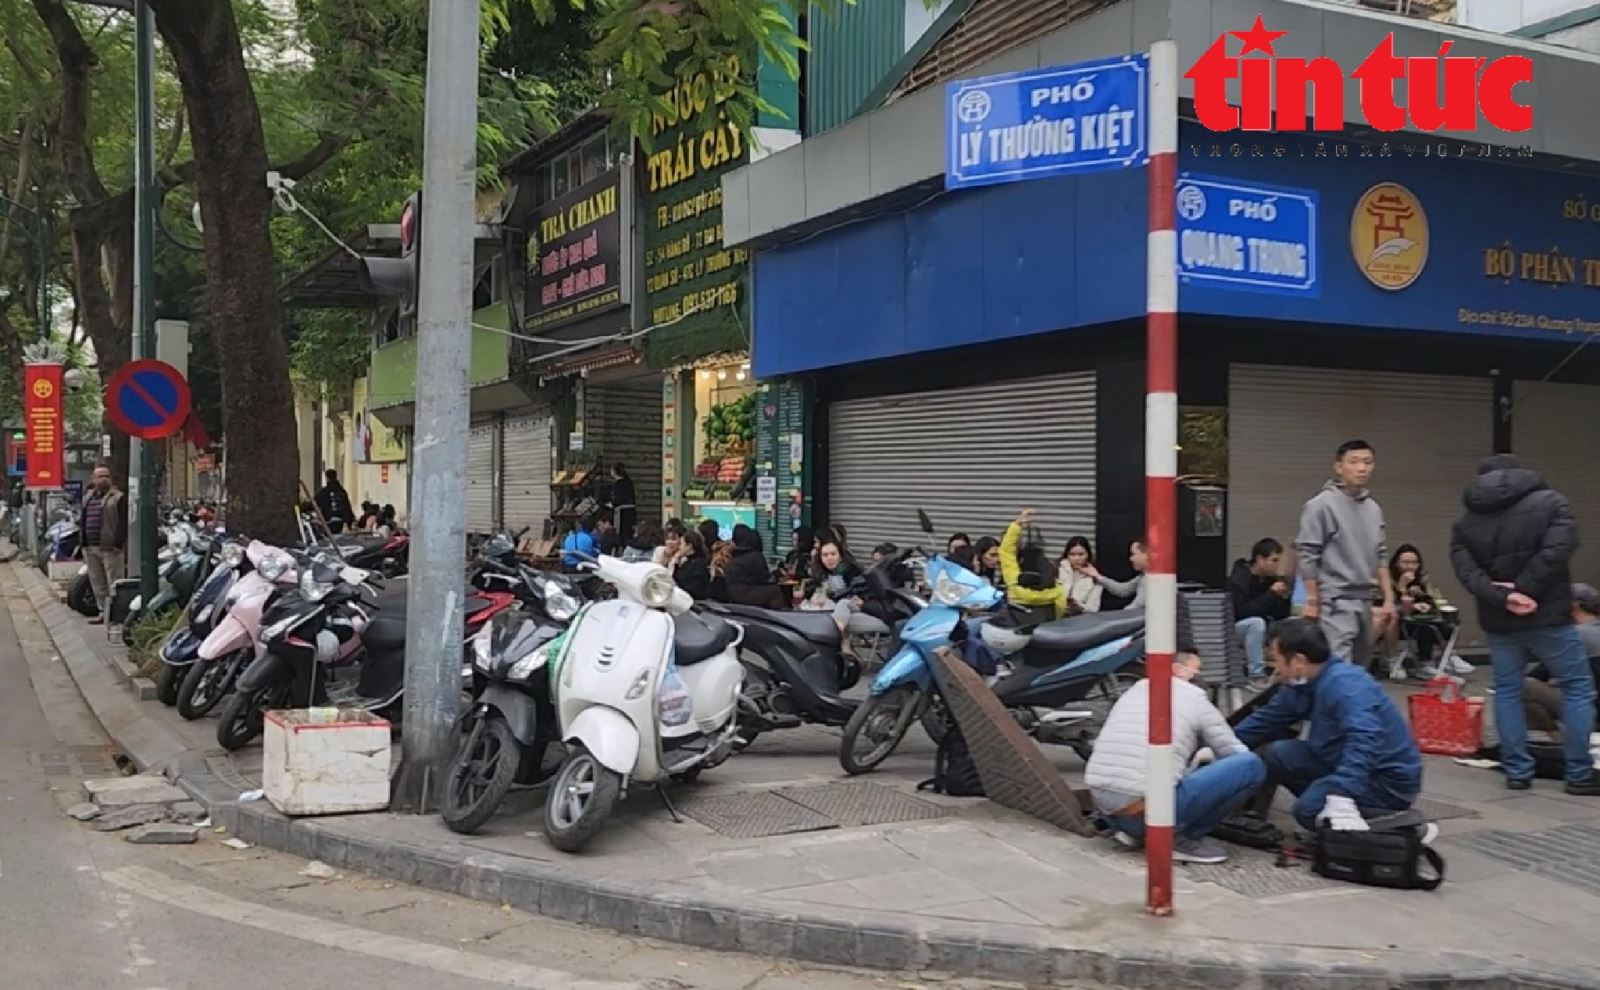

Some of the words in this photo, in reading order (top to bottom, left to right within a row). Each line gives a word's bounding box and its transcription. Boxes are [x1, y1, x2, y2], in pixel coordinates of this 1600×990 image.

[1031, 74, 1098, 107] PHỐ
[960, 125, 983, 167] LÝ
[988, 115, 1075, 162] THƯỜNG
[1081, 104, 1134, 154] KIỆT
[648, 132, 695, 192] TRÁI
[541, 205, 566, 244] TRÀ
[568, 186, 616, 232] CHANH
[1229, 197, 1279, 222] PHỐ
[1564, 193, 1586, 219] SỞ
[1484, 240, 1515, 285] BỘ
[1520, 246, 1575, 289] PHẬN
